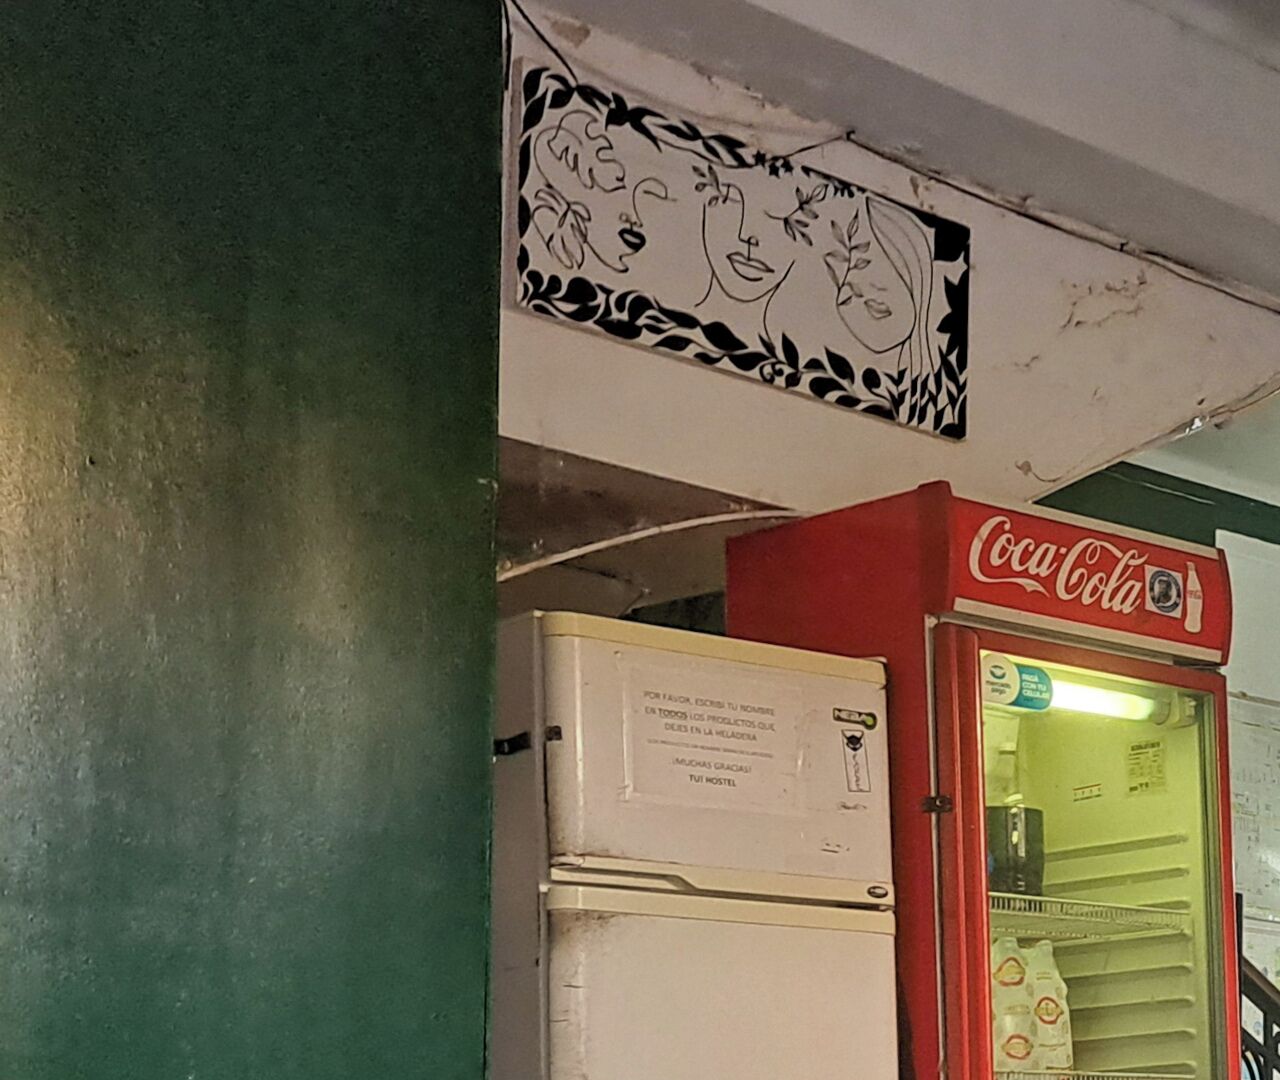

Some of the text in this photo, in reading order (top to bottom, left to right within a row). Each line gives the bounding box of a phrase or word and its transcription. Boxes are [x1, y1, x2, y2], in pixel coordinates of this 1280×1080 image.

[643, 690, 661, 701] POR
[727, 702, 738, 712] TU
[645, 706, 657, 715] EN
[658, 707, 688, 720] TODOS
[690, 713, 706, 723] LOS
[706, 714, 756, 730] PRODUCTOS
[664, 721, 758, 742] DEJES EN LA HELADERA
[705, 776, 737, 788] HOSTEL
